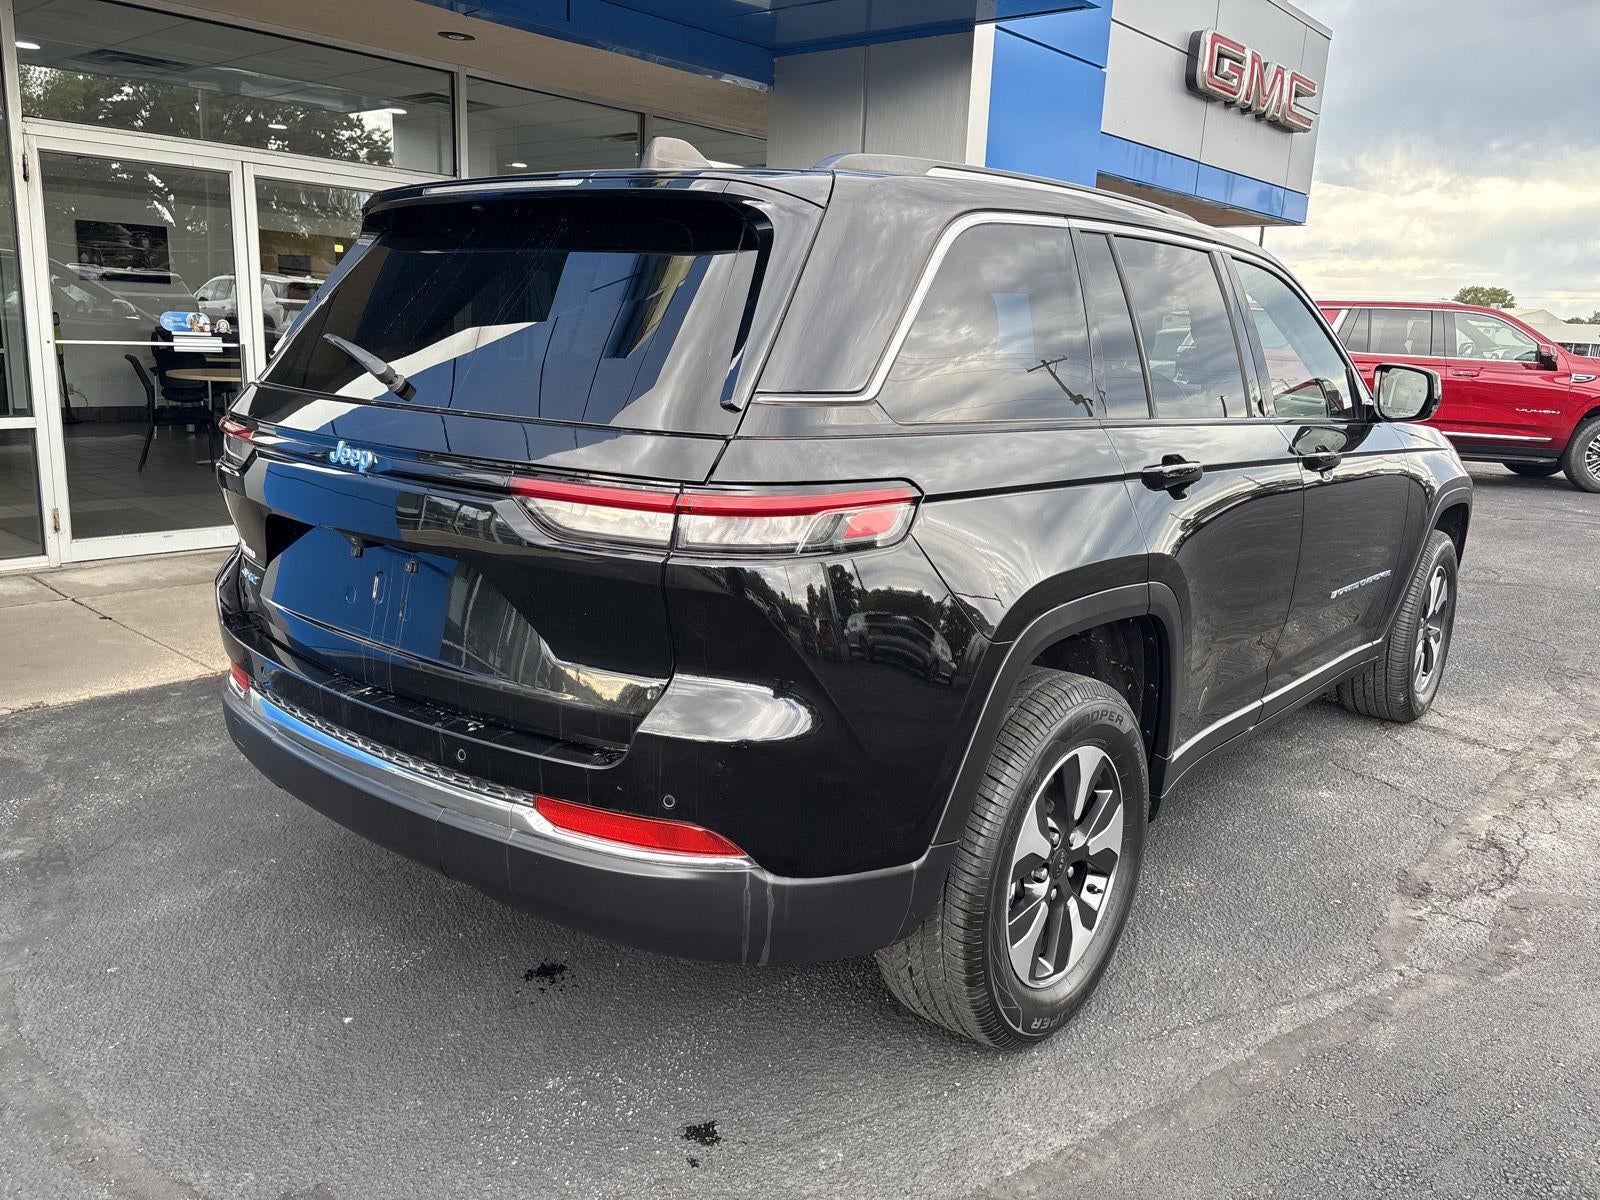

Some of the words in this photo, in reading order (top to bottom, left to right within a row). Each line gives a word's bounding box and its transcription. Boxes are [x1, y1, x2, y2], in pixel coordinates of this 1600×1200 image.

[1194, 28, 1318, 133] GMC
[329, 440, 374, 473] Jeep
[1071, 709, 1124, 735] COOPER
